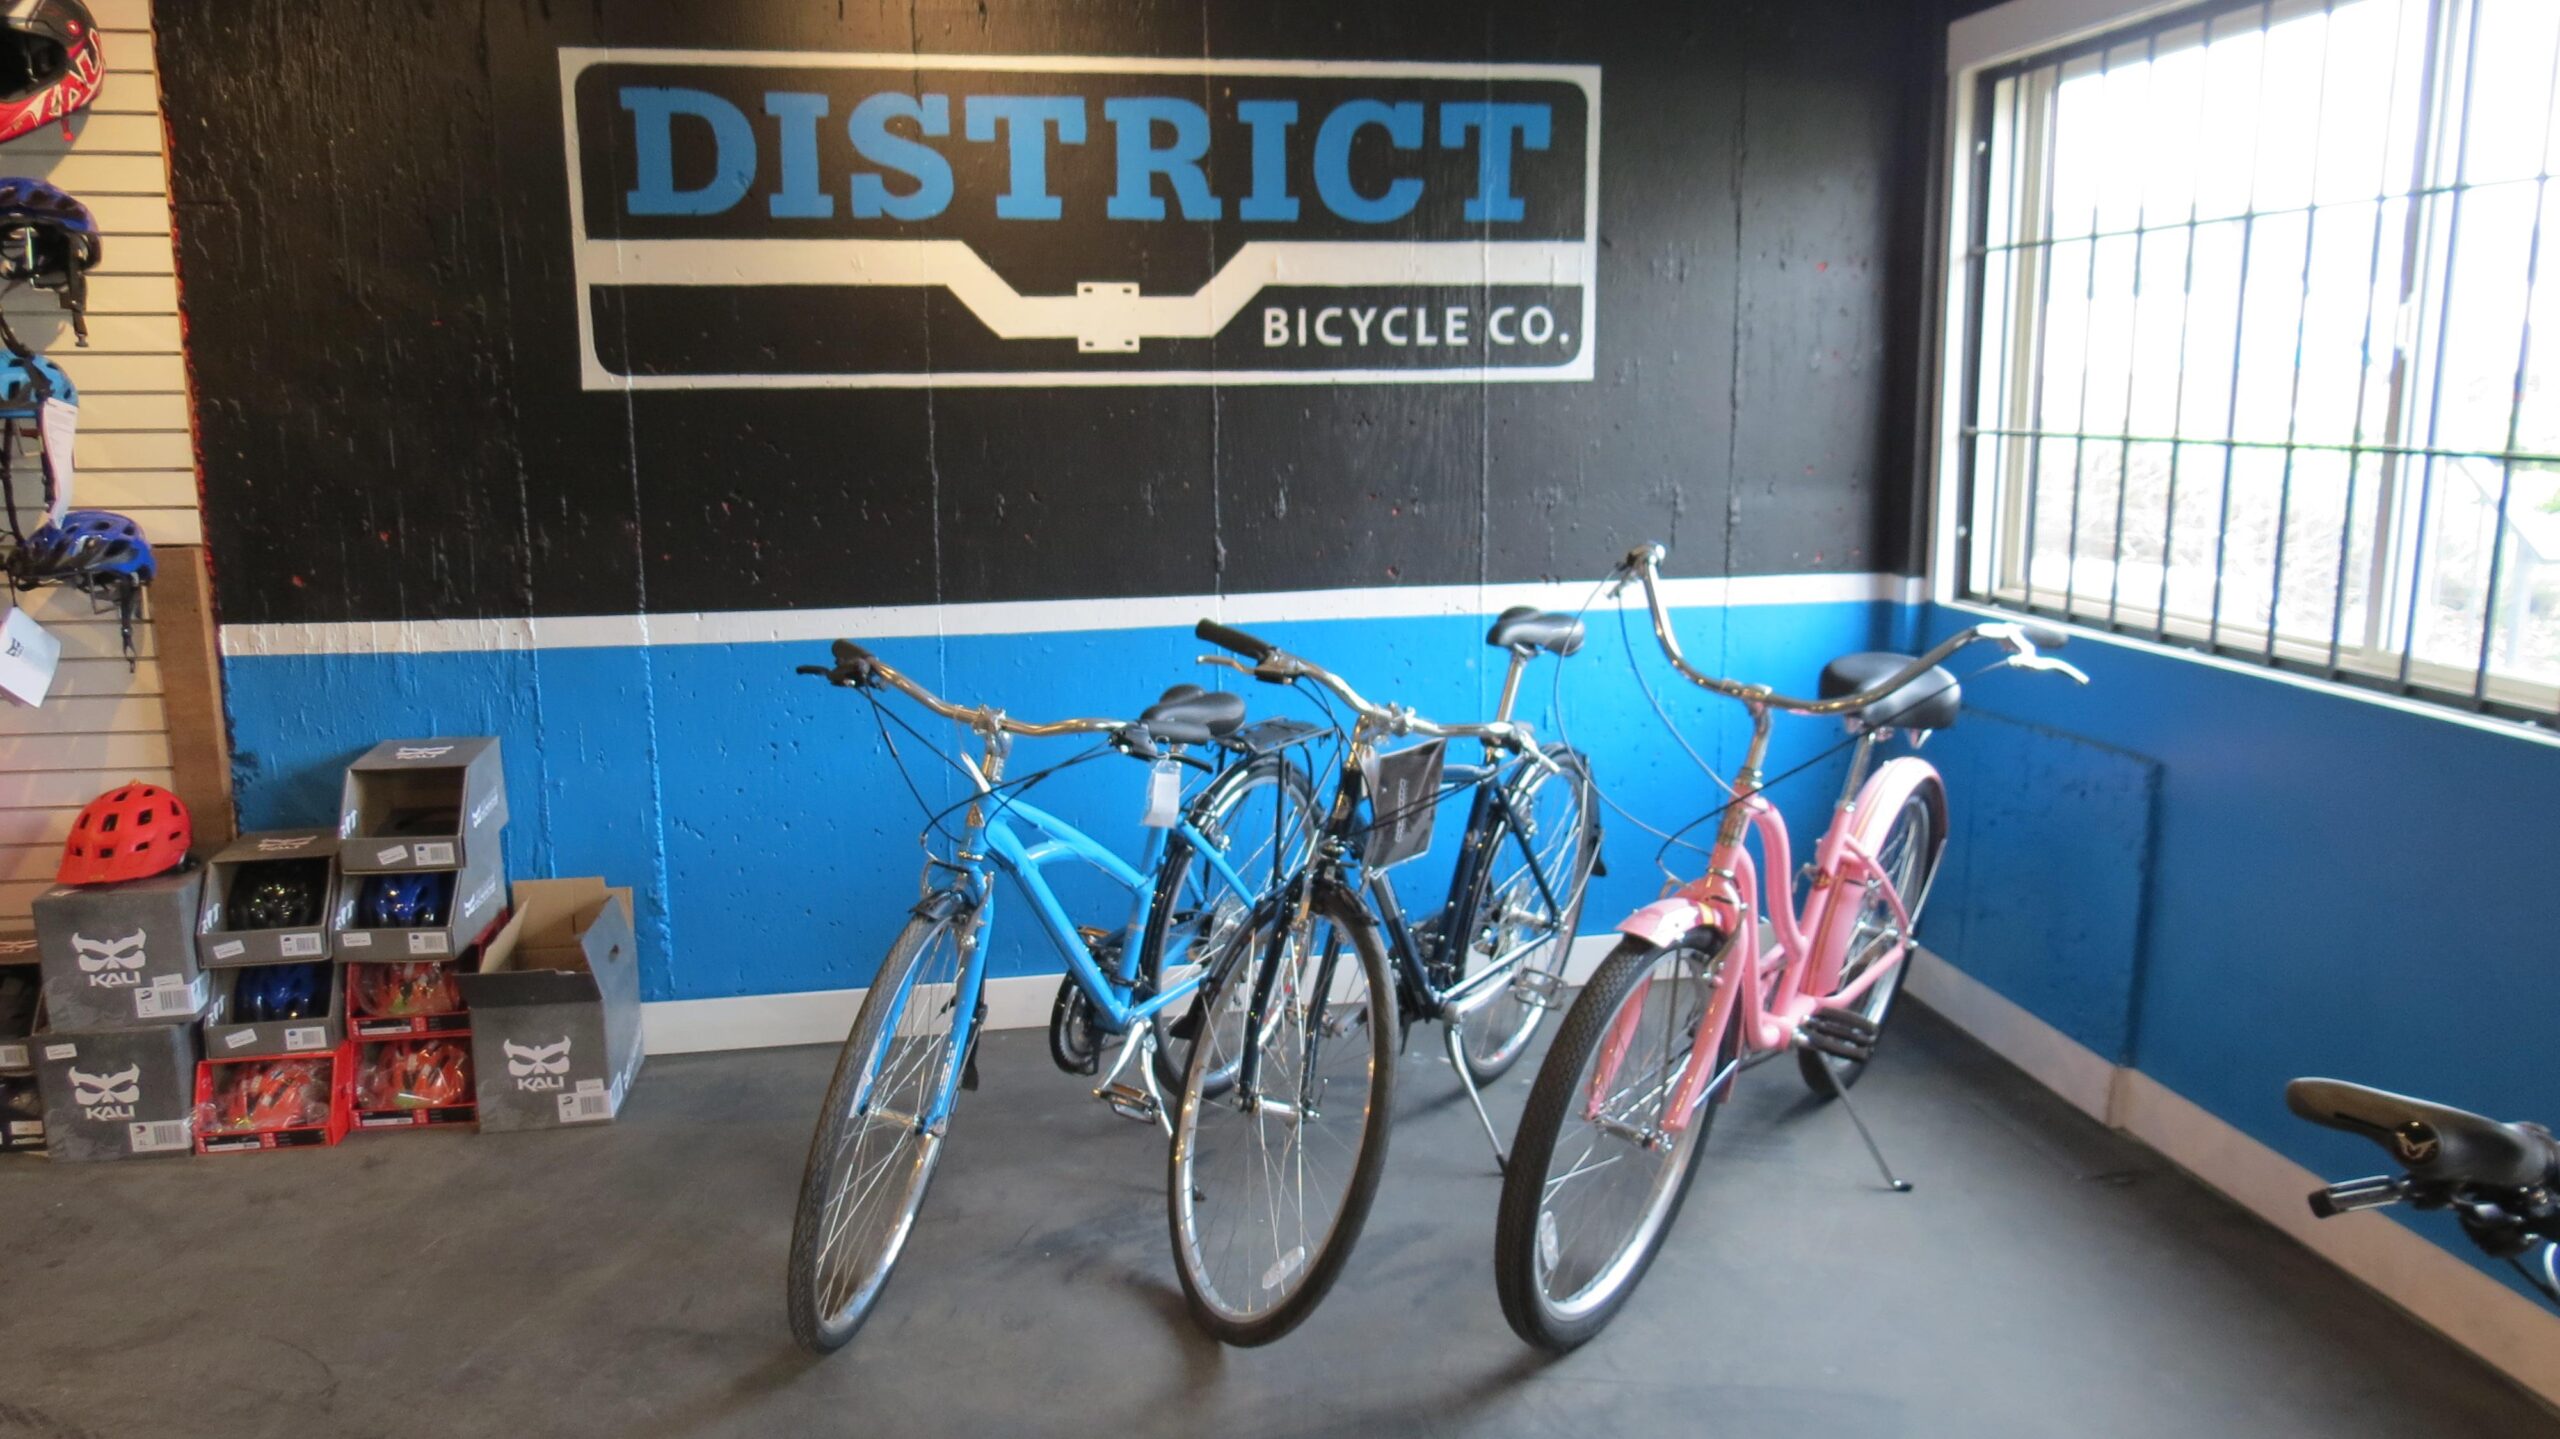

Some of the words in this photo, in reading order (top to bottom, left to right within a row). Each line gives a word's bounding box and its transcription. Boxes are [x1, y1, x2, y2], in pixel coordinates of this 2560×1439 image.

[619, 87, 1551, 223] DISTRICT
[1264, 307, 1468, 347] BICYCLE
[1489, 306, 1569, 346] CO.
[89, 970, 141, 988] KALI
[517, 1076, 565, 1092] KALI
[85, 1105, 136, 1121] KALI
